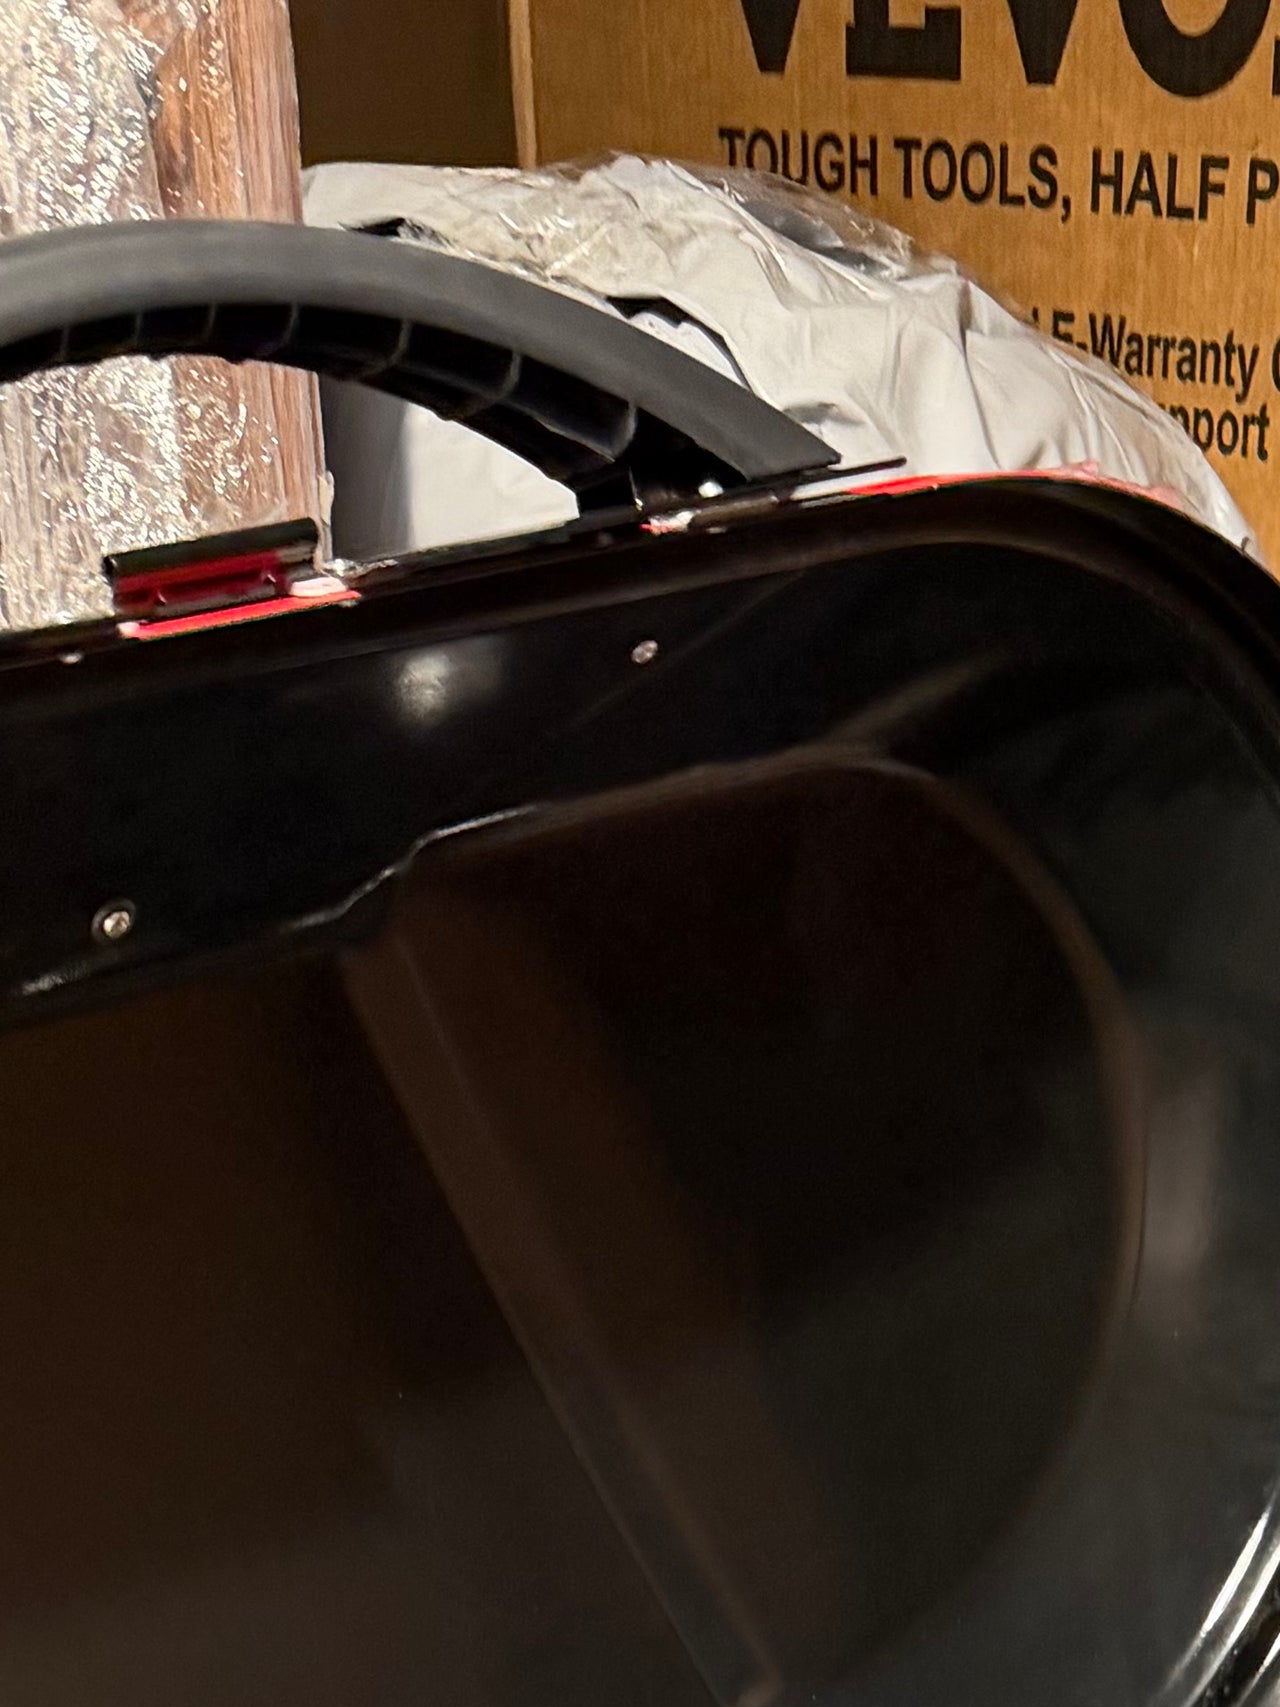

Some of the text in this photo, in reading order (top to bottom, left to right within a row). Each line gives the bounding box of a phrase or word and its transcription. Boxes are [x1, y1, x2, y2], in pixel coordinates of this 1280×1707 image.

[719, 127, 878, 197] TOUGH
[894, 137, 1070, 223] TOOLS,
[1090, 147, 1228, 222] HALF
[1052, 309, 1259, 402] E-Warranty
[1158, 402, 1270, 461] port
